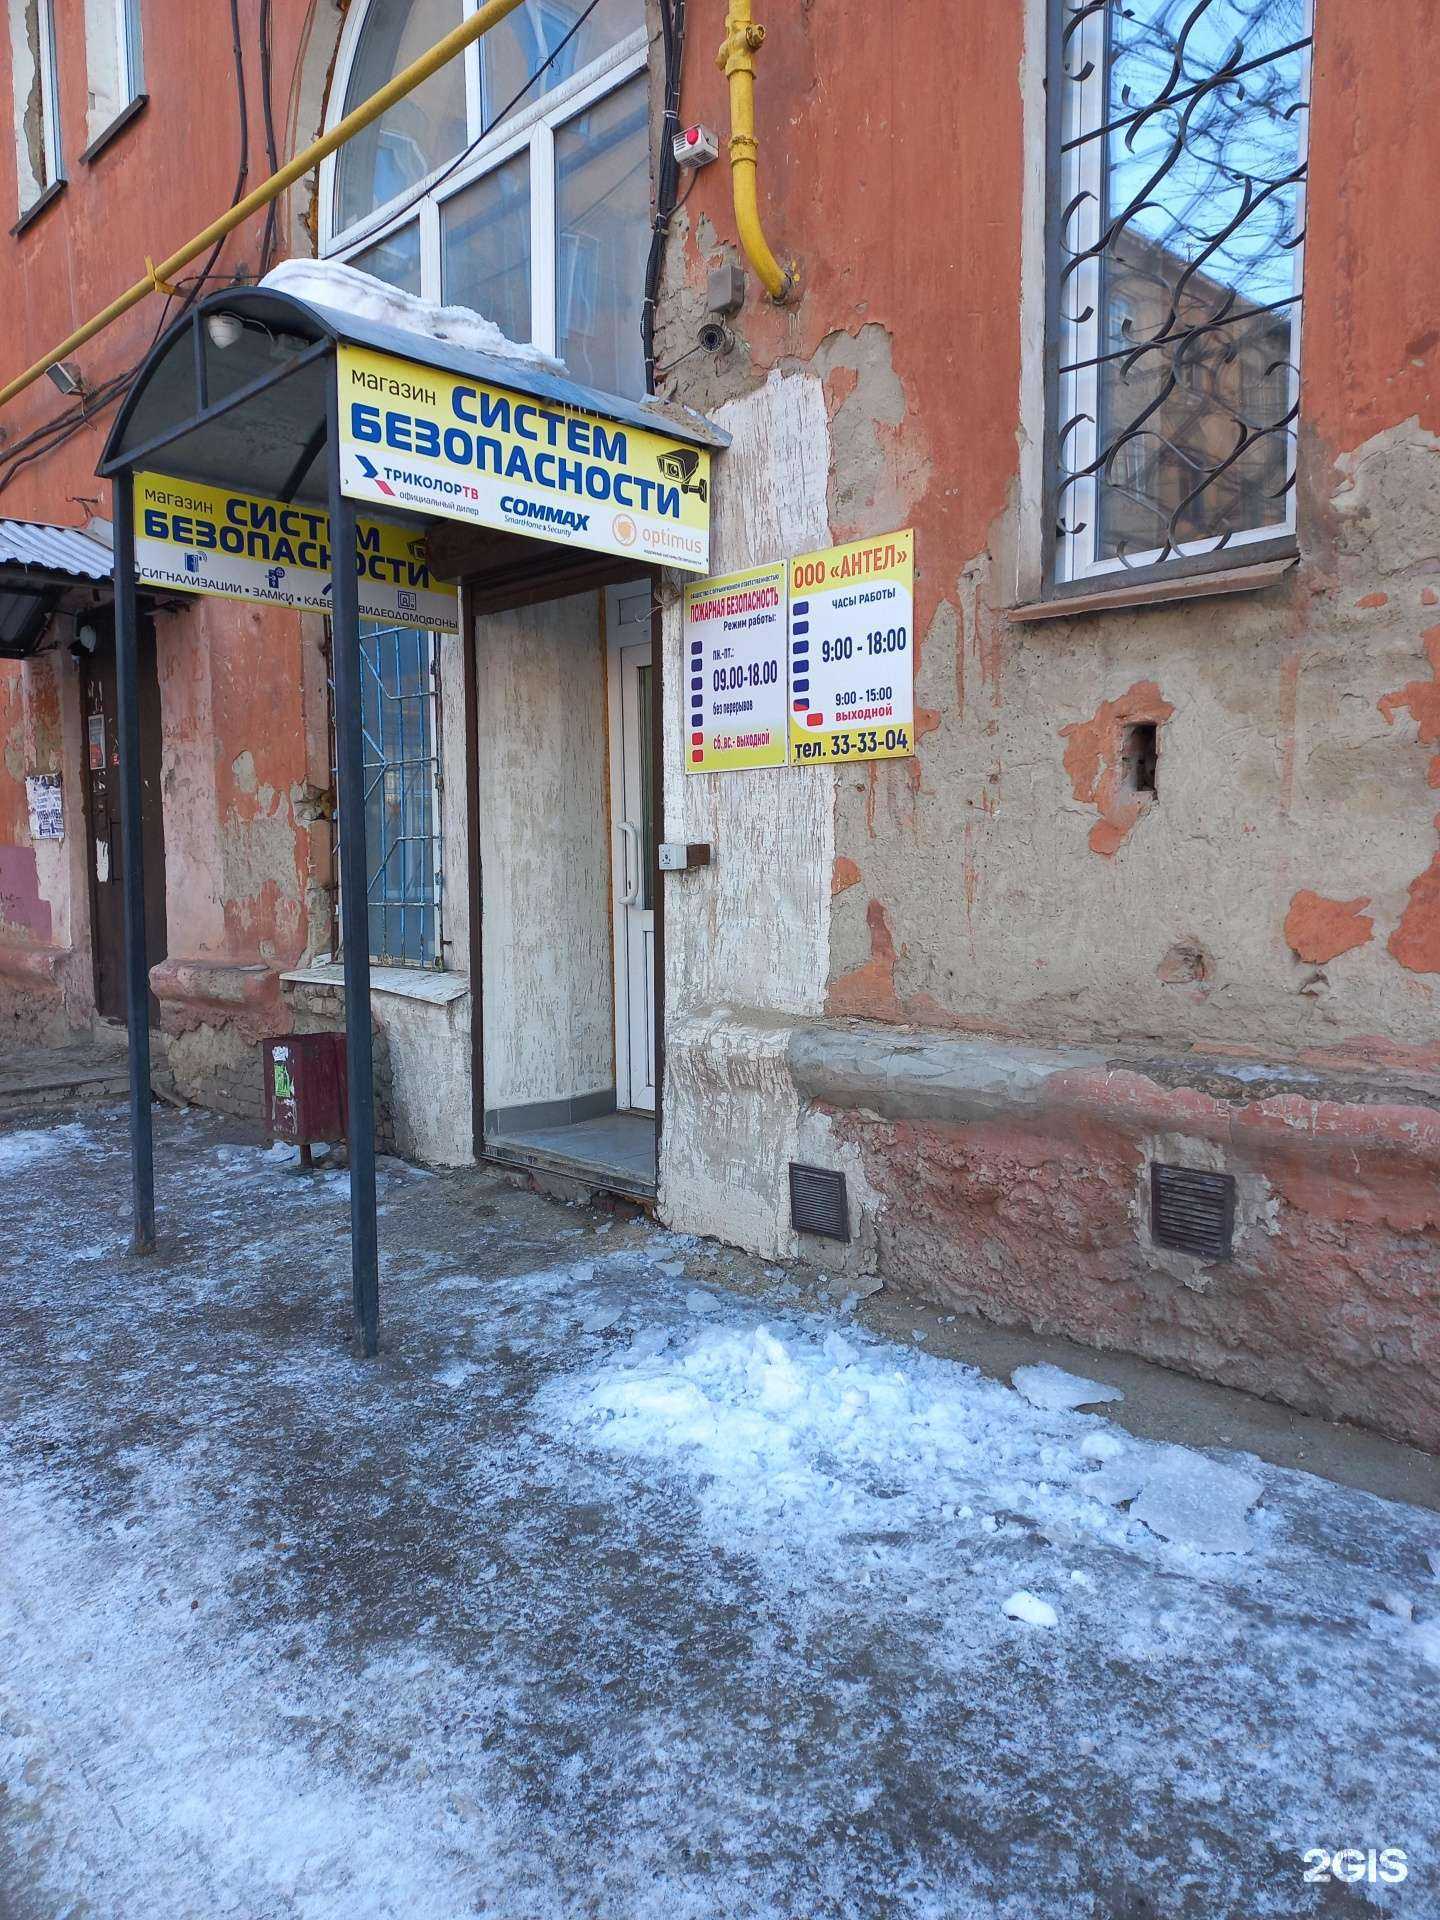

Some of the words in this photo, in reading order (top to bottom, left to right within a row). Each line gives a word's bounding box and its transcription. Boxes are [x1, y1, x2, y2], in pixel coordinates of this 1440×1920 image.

[351, 369, 436, 405] магазин
[451, 385, 628, 465] СИСТЕМ
[351, 402, 680, 519] БЕЗОПАСНОСТИ
[144, 488, 213, 514] магазин
[226, 498, 380, 553] СИСТМ
[400, 491, 455, 511] официальный
[455, 505, 479, 517] дилер
[500, 496, 590, 531] COMMAX
[642, 527, 703, 554] optimus
[794, 561, 825, 588] ООО
[830, 544, 907, 578] «АНТЕЛ»
[142, 567, 242, 594] СИГНАЛИЗАЦИИ
[252, 587, 294, 603] ЗАМКИ
[358, 605, 458, 629] ВИДЕОДОМОФОНЫ
[690, 598, 726, 623] ПОЖАРНАЯ
[726, 586, 779, 616] БЕЗОПАСНОСТЬ
[832, 595, 856, 609] ЧАСЫ
[859, 587, 896, 604] РАБОТЫ
[723, 619, 747, 631] Режим
[748, 613, 777, 629] работы:
[822, 636, 852, 662] 9:00
[867, 627, 906, 655] 18:00
[713, 659, 778, 692] 09.00-18.00
[713, 701, 723, 715] без
[723, 700, 753, 716] перерывов
[835, 691, 856, 706] 9:00
[866, 686, 892, 702] 15:00
[794, 741, 827, 759] тел.
[831, 729, 908, 756] 33-33-04
